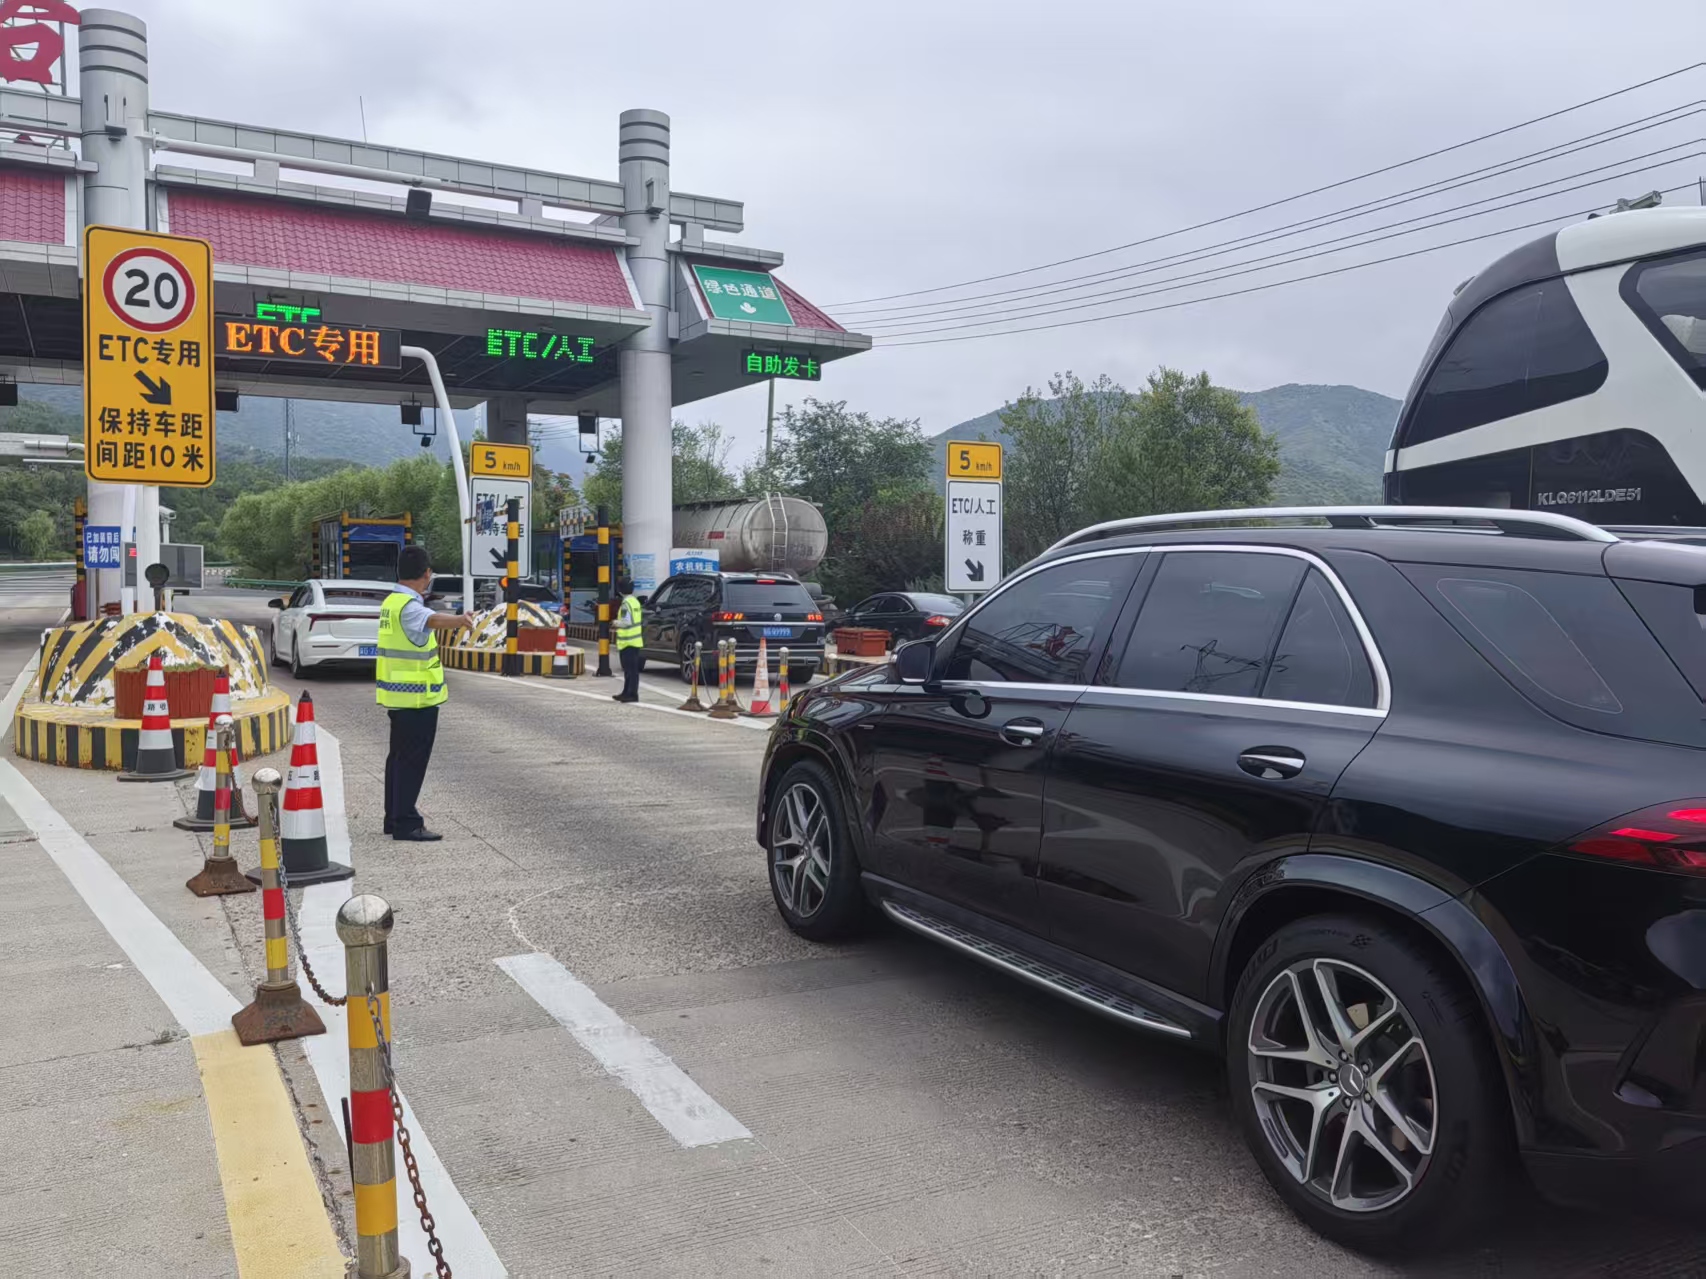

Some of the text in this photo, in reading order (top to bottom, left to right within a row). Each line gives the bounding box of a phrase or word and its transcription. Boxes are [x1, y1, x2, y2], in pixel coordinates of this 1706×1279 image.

[124, 268, 179, 310] 20
[703, 279, 778, 300] 绿色通道
[98, 333, 201, 368] ETC专用
[225, 322, 380, 365] ETC专用
[487, 328, 594, 363] ETC/人工
[746, 352, 819, 378] 自助发卡
[97, 406, 203, 439] 保持车距
[485, 450, 520, 471] 5 km/h
[959, 450, 992, 472] 5 km/h
[952, 497, 996, 515] ETC/人工
[1537, 487, 1641, 506] KLQ6112LDE51
[962, 529, 987, 546] 称重
